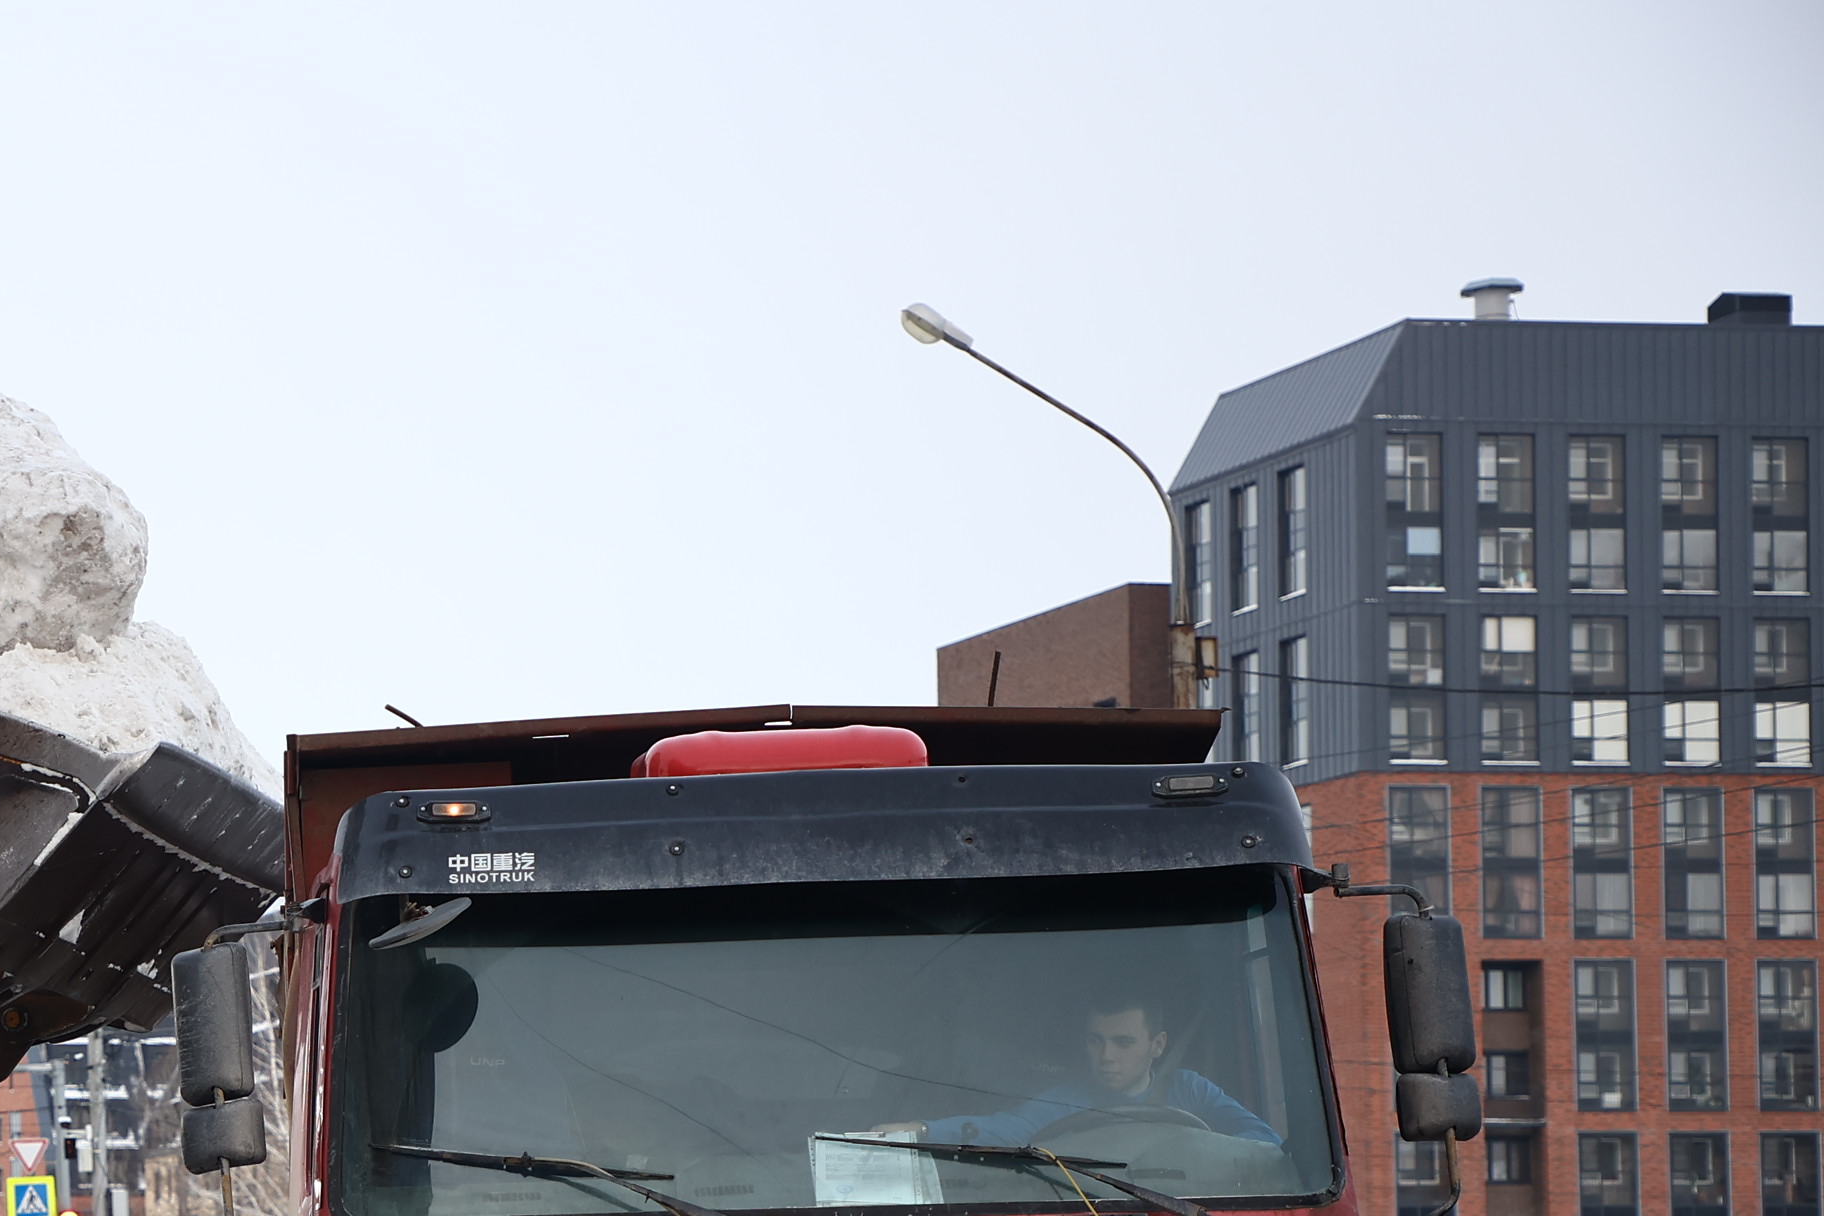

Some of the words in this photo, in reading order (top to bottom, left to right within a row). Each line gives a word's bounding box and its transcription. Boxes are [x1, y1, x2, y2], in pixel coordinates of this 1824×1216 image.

[448, 852, 535, 872] 中国重汽
[448, 871, 535, 885] SINOTRUK
